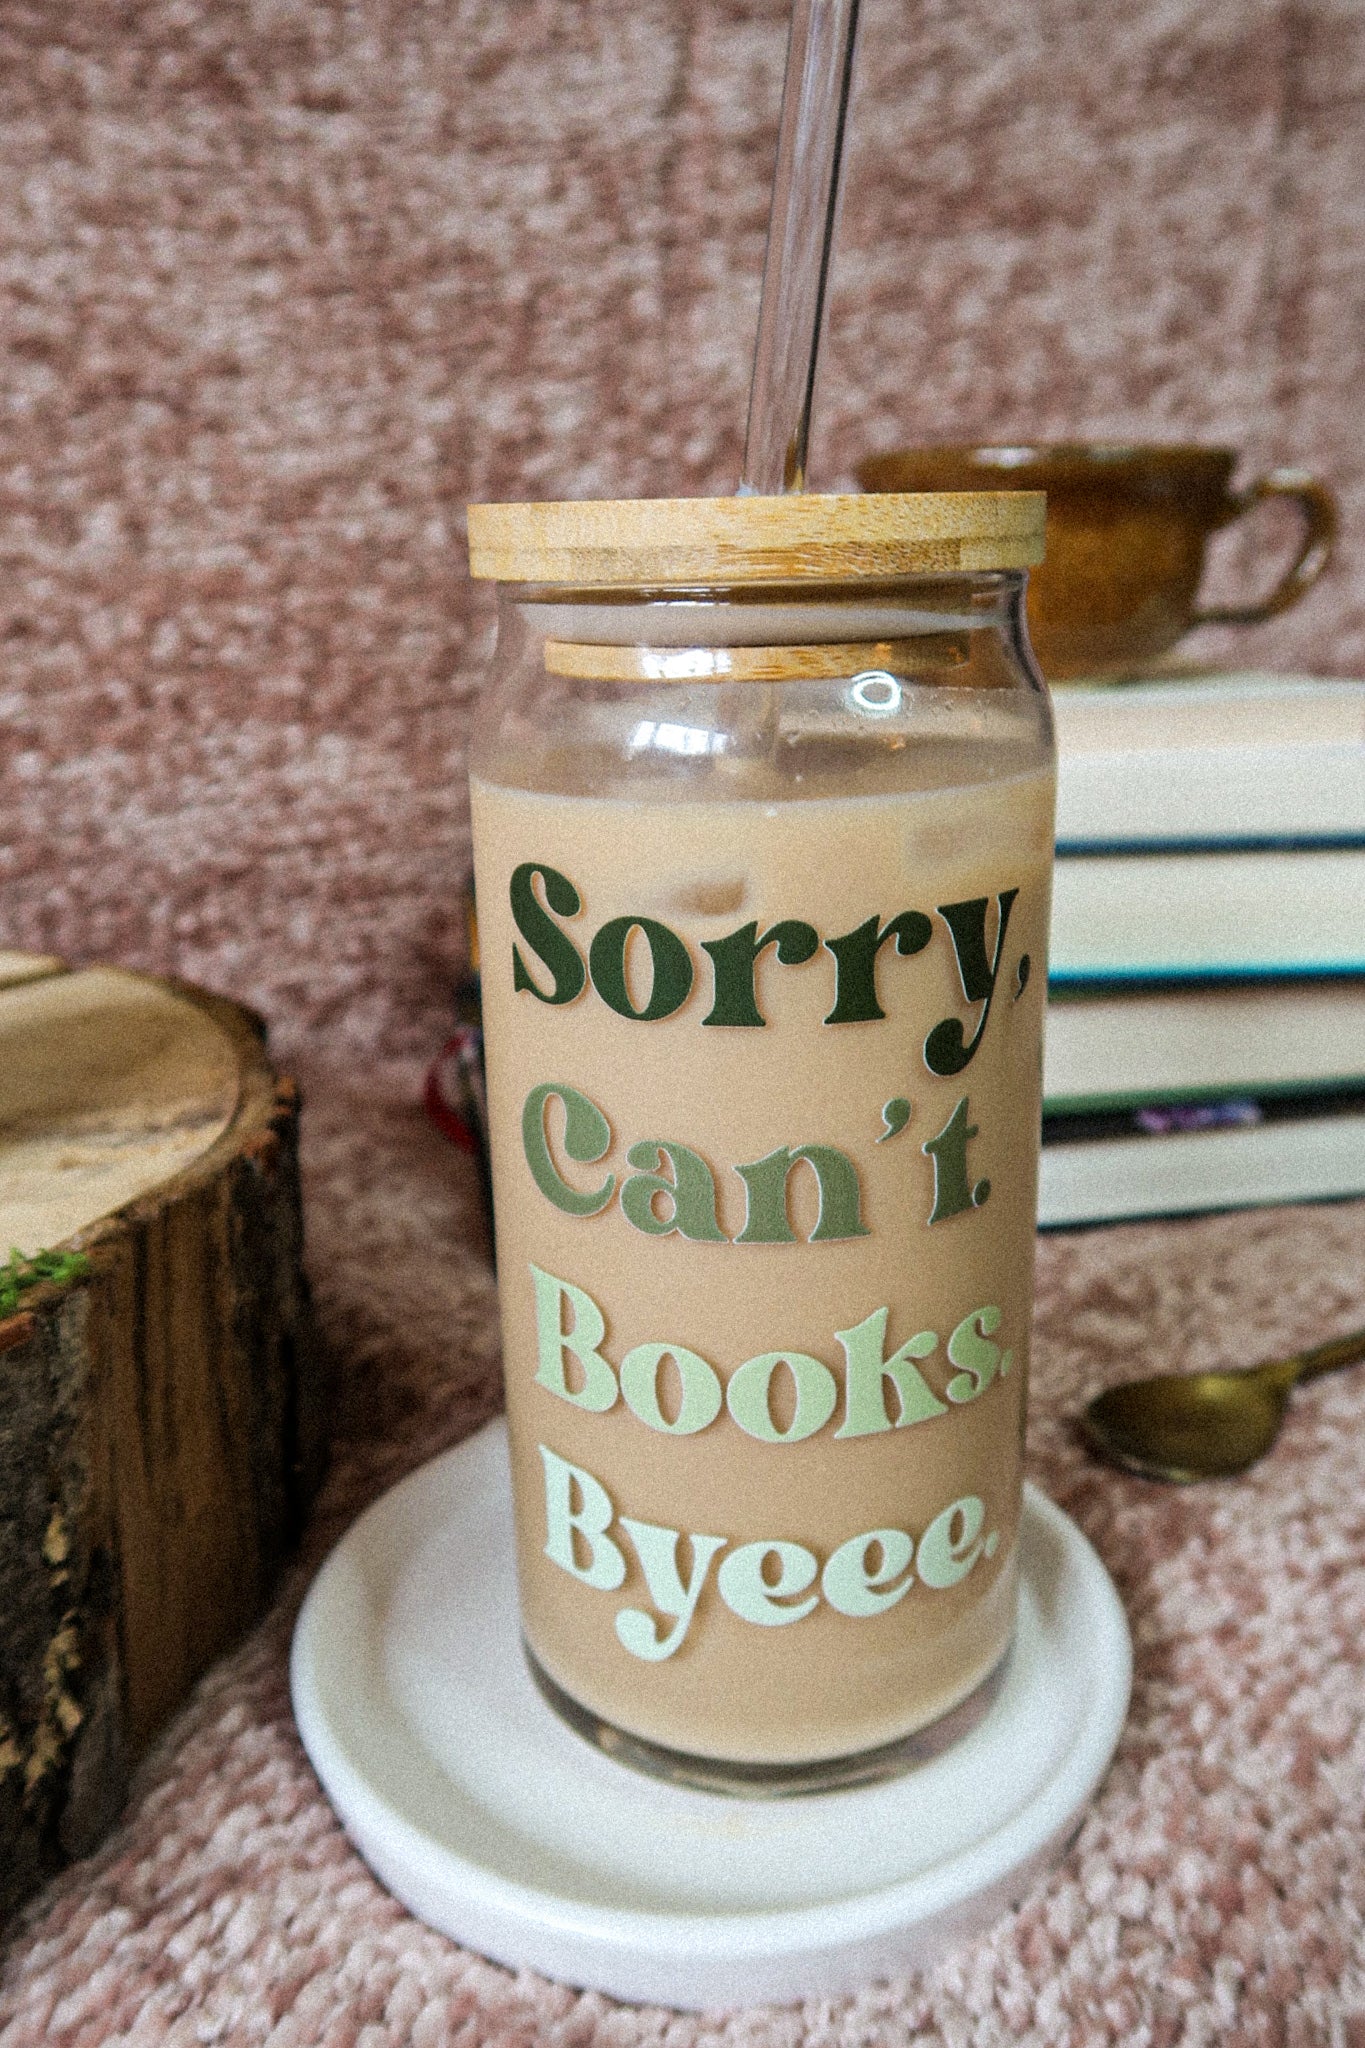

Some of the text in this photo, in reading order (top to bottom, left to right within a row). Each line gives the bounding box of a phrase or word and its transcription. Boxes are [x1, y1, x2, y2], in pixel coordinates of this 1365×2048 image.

[509, 861, 1031, 1076] Sorry,
[521, 1082, 991, 1244] Can't.
[528, 1262, 1014, 1443] Books.
[537, 1444, 999, 1662] Byeee.
